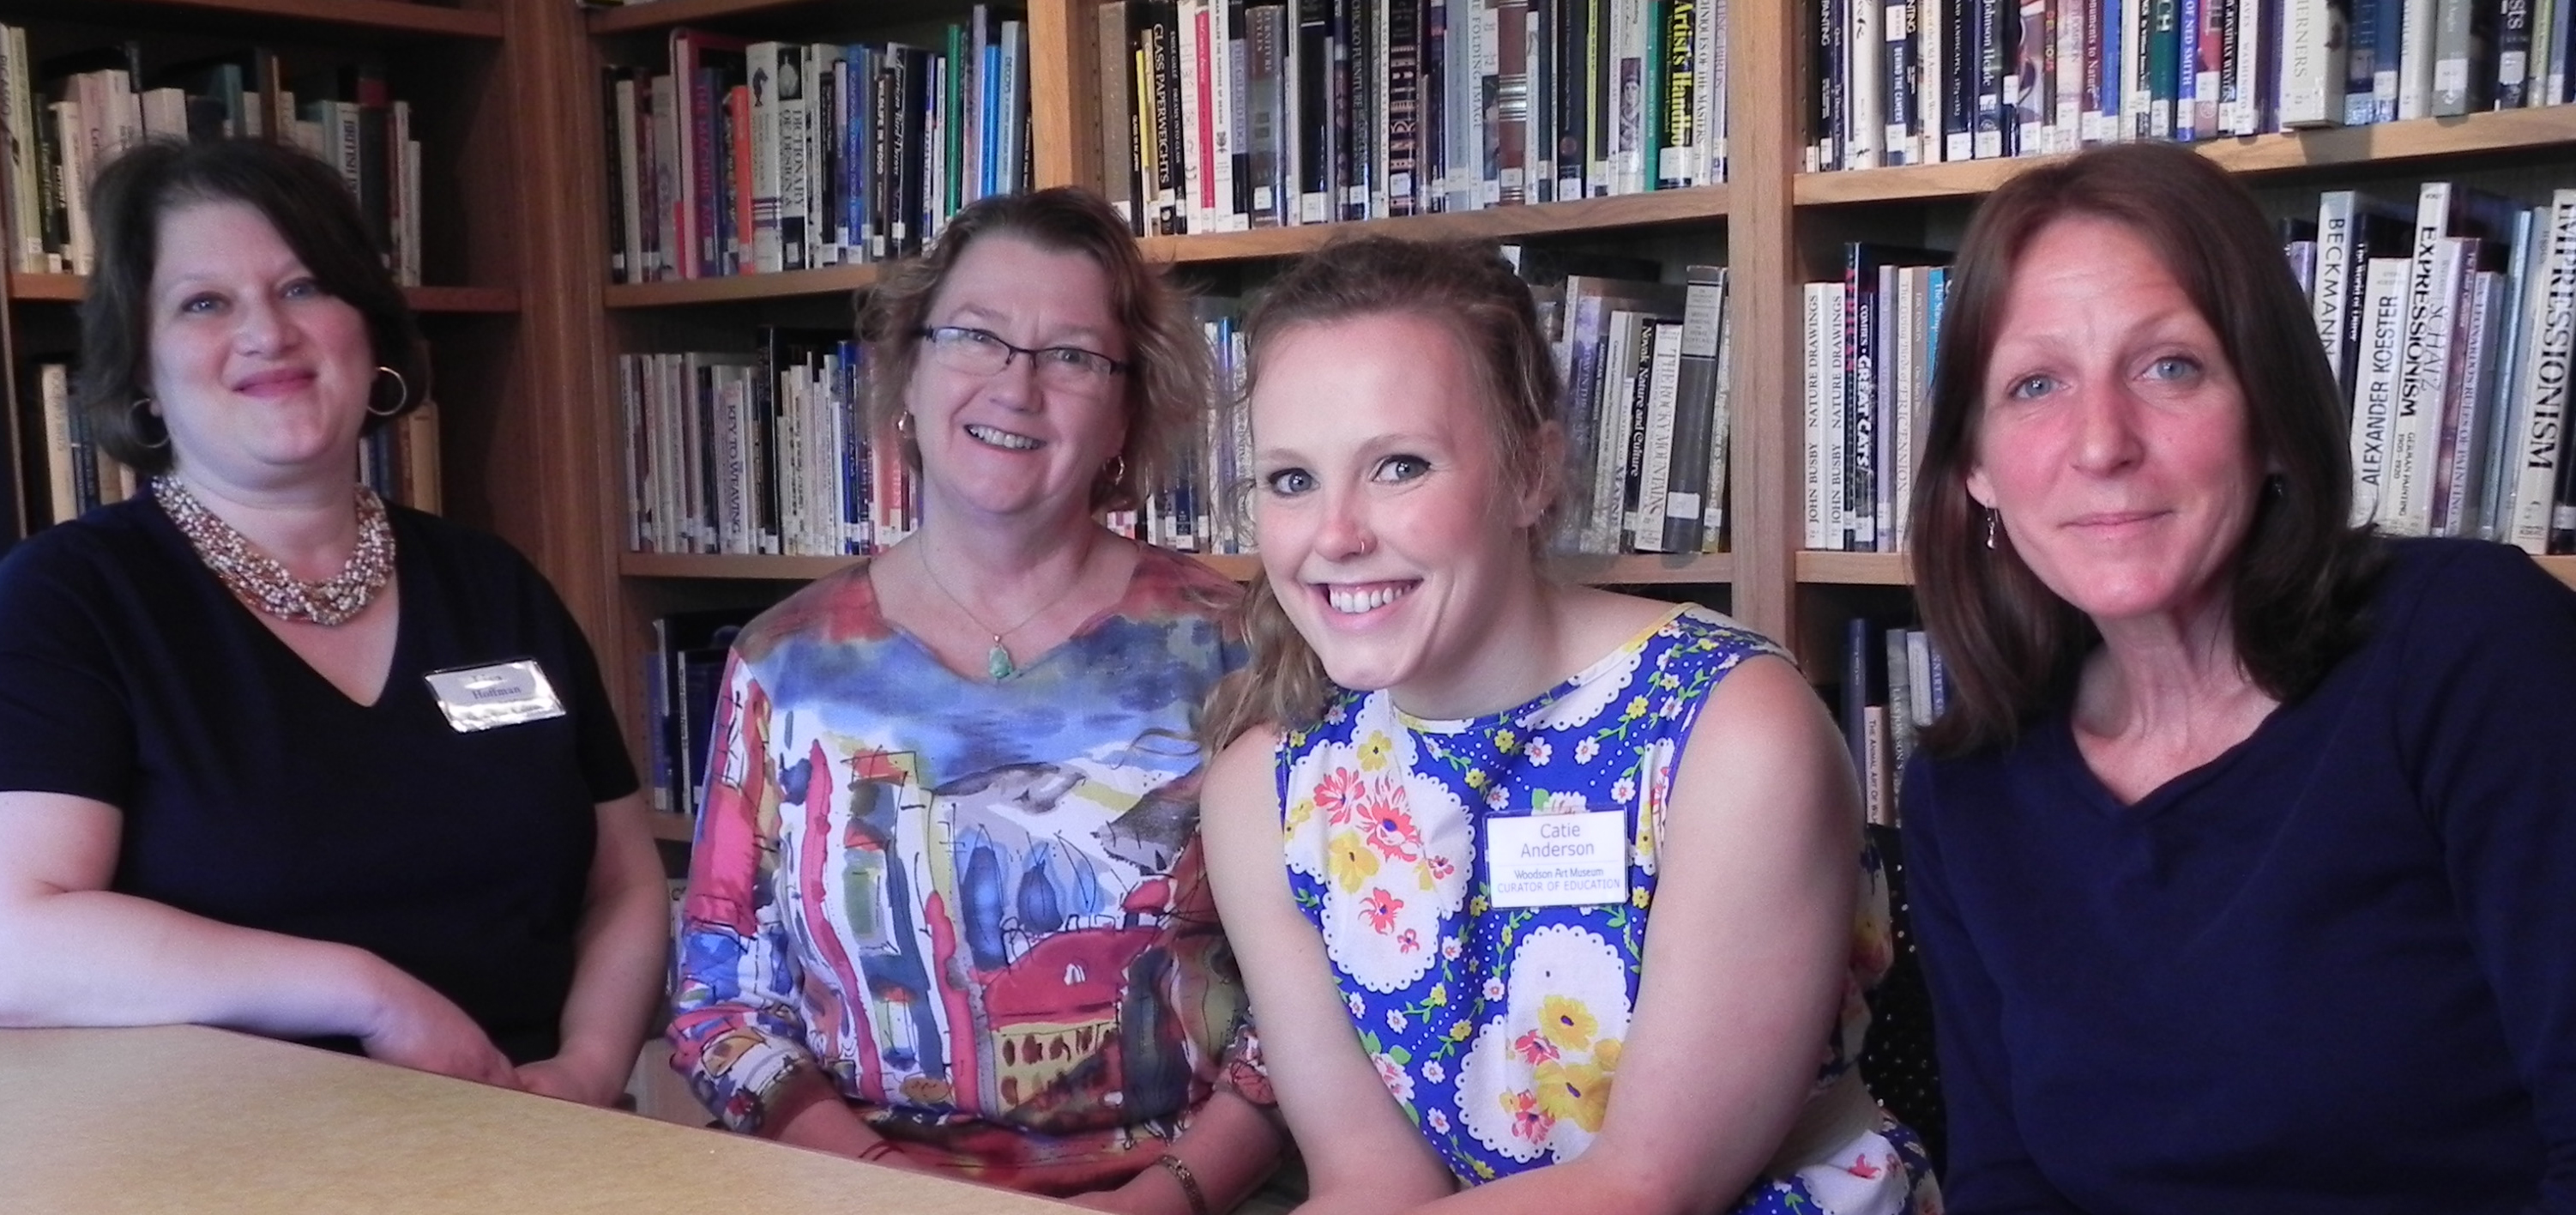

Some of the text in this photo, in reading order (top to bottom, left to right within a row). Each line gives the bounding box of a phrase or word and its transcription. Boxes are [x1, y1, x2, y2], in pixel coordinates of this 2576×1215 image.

[1264, 10, 1272, 73] FURNITURE
[1982, 0, 1997, 46] Johnson
[2182, 1, 2193, 86] OF NED SMITH
[1004, 57, 1012, 94] DECOYS
[1352, 47, 1363, 108] FURNITURE
[1471, 16, 1482, 130] FOLDING IMAGE
[1670, 1, 1693, 147] Artist's Handbo
[1698, 51, 1709, 67] OF
[1698, 70, 1709, 90] THE
[1893, 46, 1903, 76] BEHIND
[1893, 76, 1903, 90] THE
[1927, 61, 1935, 100] American
[2087, 46, 2099, 94] to Nature
[2240, 41, 2250, 110] WASHINGTO
[696, 84, 708, 116] THE
[876, 80, 884, 127] WILDLIFE
[1152, 23, 1170, 184] GLASS PAPERWEIGHTS
[1235, 69, 1245, 117] GILDED
[1893, 91, 1903, 123] CAMERA
[1696, 94, 1709, 144] MASTERS
[697, 120, 711, 199] MACHINE
[791, 109, 805, 209] DICTIONARY
[2320, 218, 2346, 355] BECKMANN
[1831, 295, 1843, 370] DRAWINGS
[2399, 225, 2438, 417] EXPRESSIONISM
[2527, 202, 2576, 471] IMPRESSIONISM
[1630, 325, 1654, 477] Novak Nature and Culture
[1808, 294, 1819, 524] JOHN BUSBY NATURE DRAWINGS
[1831, 372, 1843, 429] NATURE
[1856, 305, 1873, 468] COMBES GREAT CATS
[1897, 386, 1909, 426] ERIC
[2361, 295, 2399, 486] ALEXANDER KOESTER
[1642, 348, 1678, 515] THE ROCKY MOUNTAINS
[727, 404, 741, 534] KEY TO WEAVING
[1831, 442, 1842, 484] BUSBY
[1897, 426, 1909, 493] ENNION
[2398, 432, 2416, 517] GERMAN PAINTING
[2450, 449, 2470, 511] PAINTING
[472, 686, 522, 699] Hoffman
[1933, 655, 1943, 693] NNART
[1869, 739, 1879, 770] ANIMAL
[1870, 771, 1879, 788] ART
[1871, 789, 1879, 802] OF
[1521, 841, 1596, 858] Anderson
[1540, 822, 1581, 839] Catie
[1497, 878, 1620, 894] CURATOR OF EDUCATION
[1514, 867, 1605, 880] Woodson Art Museum
